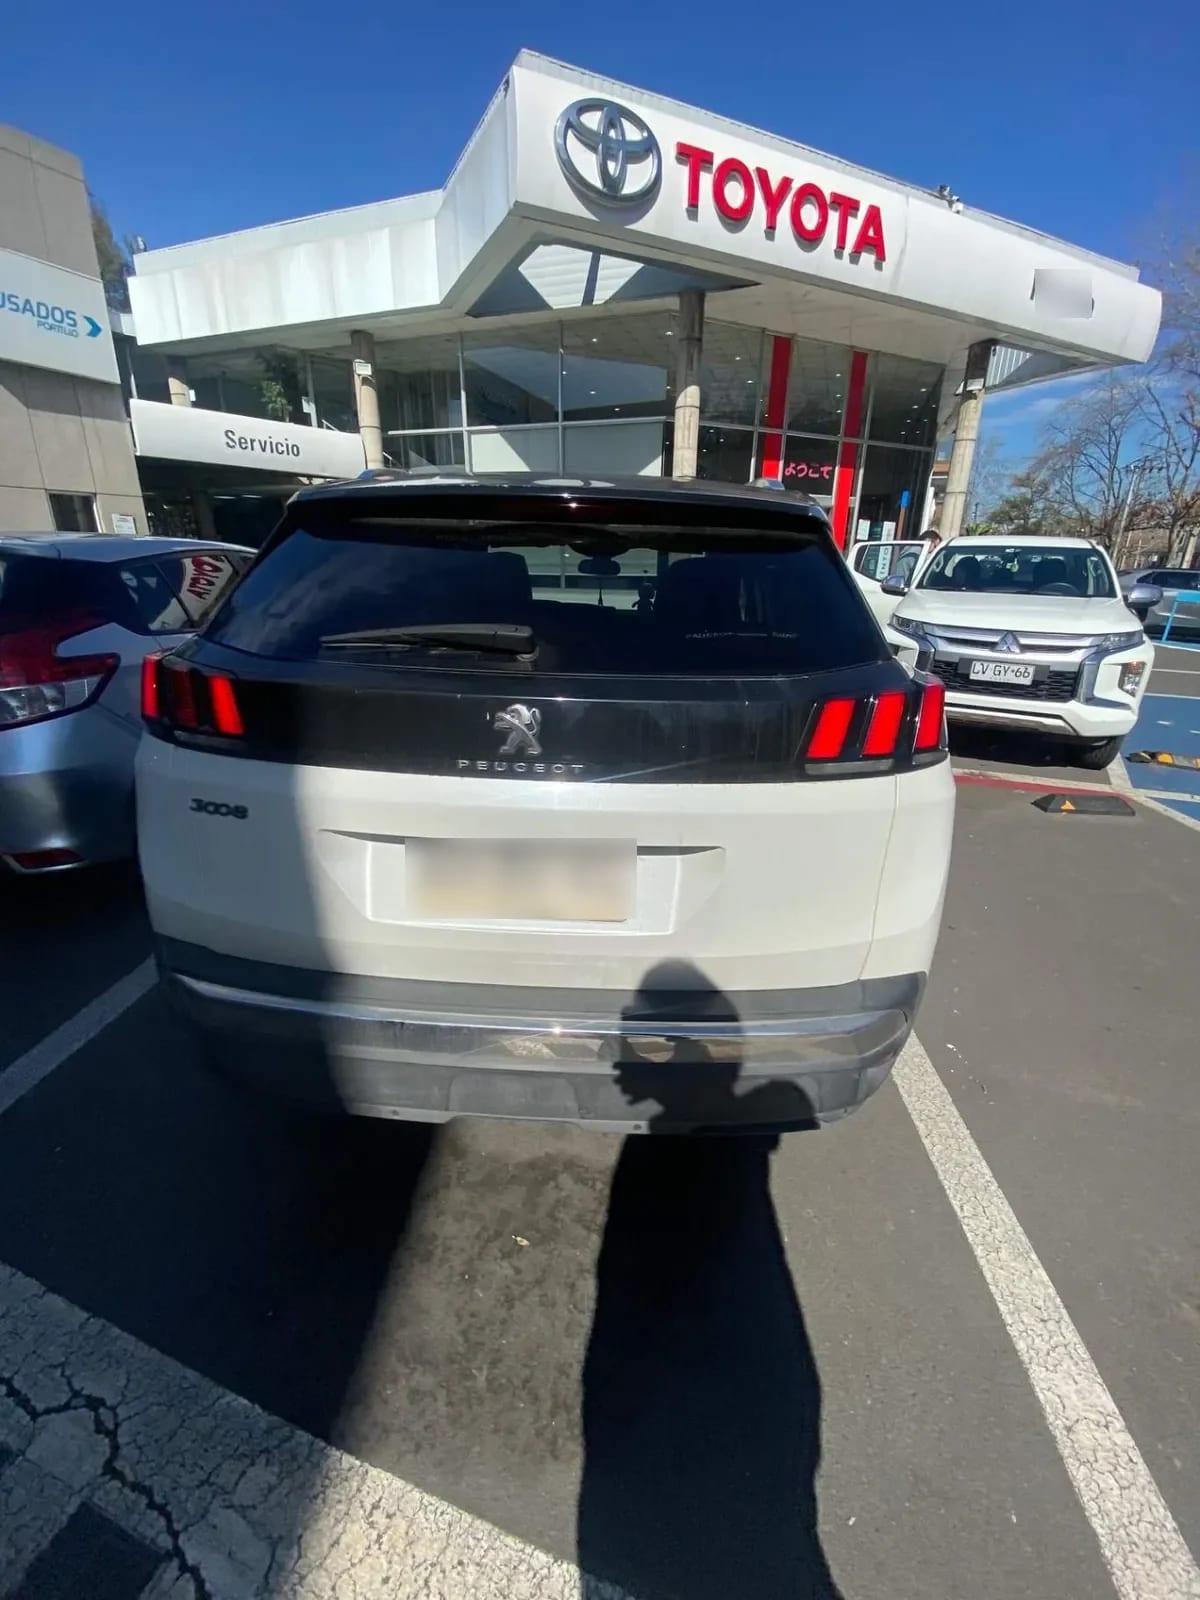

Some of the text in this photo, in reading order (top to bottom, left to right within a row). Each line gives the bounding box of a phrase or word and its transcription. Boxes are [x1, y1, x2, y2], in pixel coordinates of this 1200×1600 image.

[676, 141, 886, 262] TOYOTA
[224, 429, 300, 457] Servicio
[972, 662, 990, 675] LV
[457, 759, 584, 774] PEUGEOT
[189, 798, 248, 820] 3008
